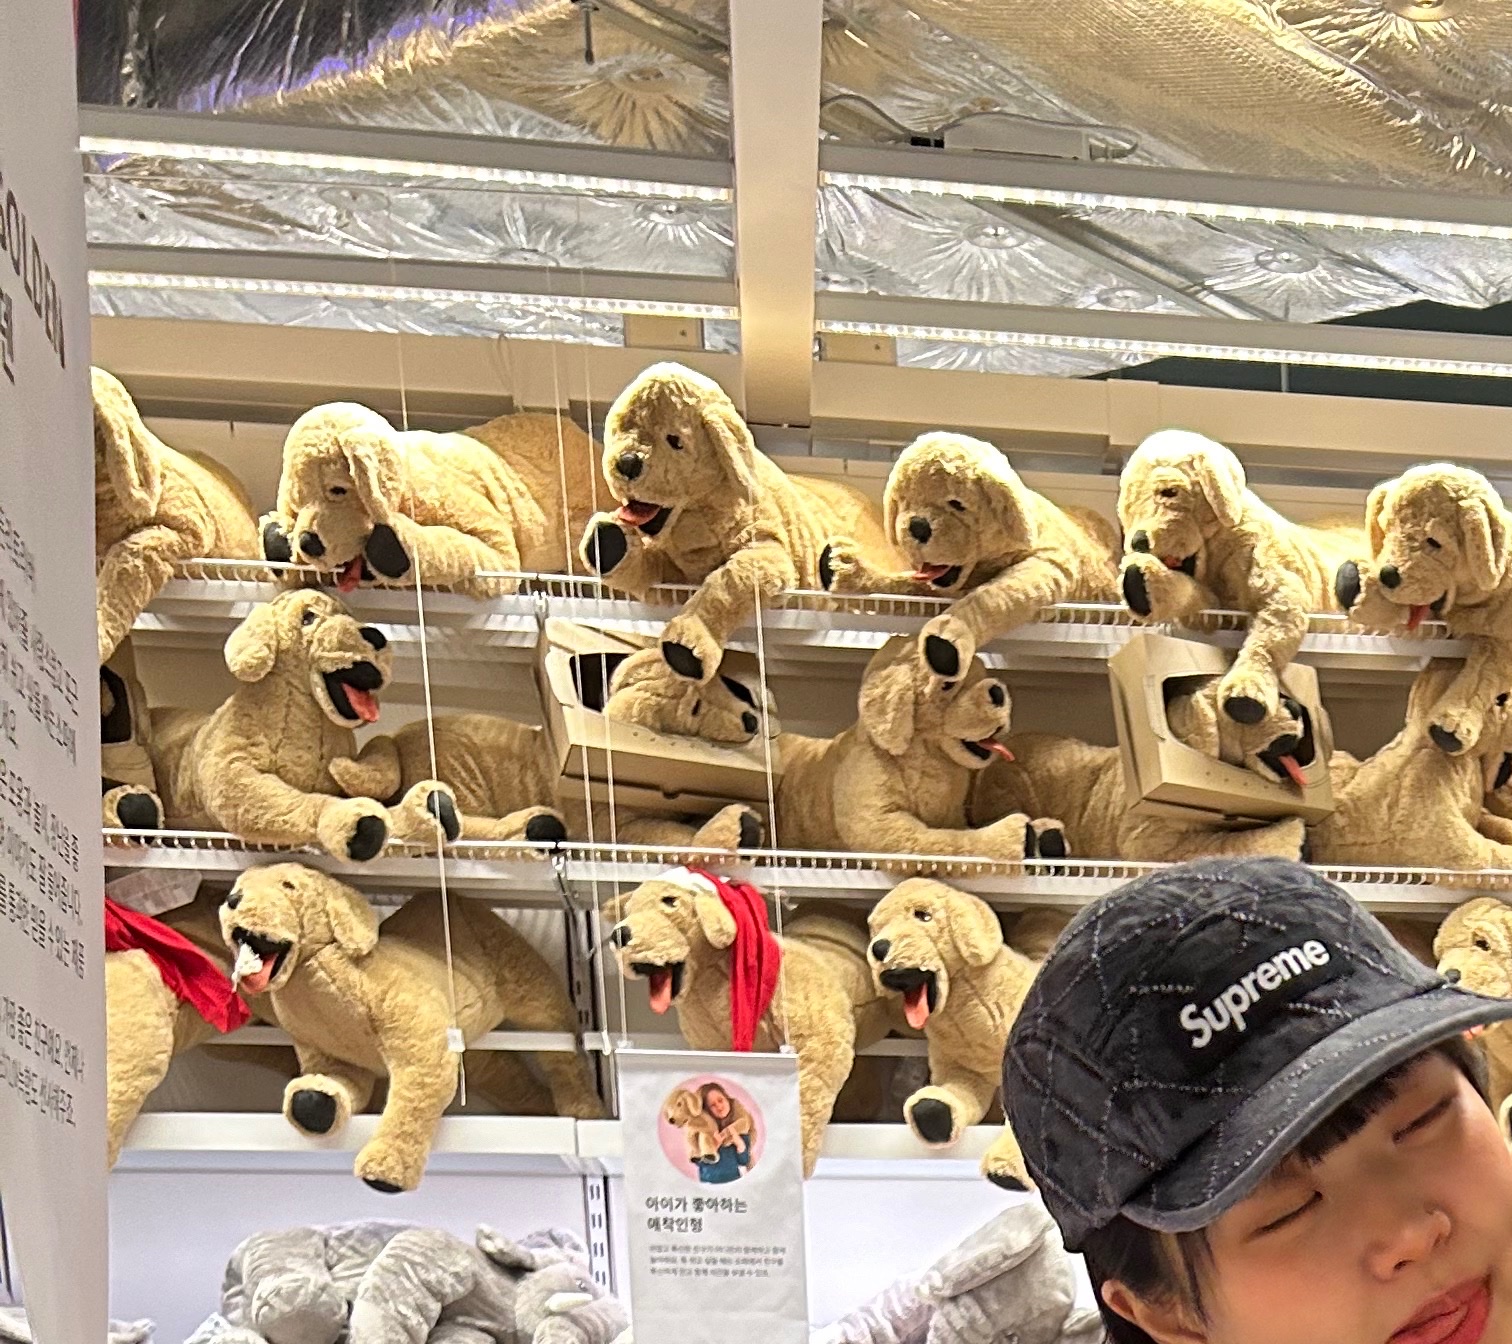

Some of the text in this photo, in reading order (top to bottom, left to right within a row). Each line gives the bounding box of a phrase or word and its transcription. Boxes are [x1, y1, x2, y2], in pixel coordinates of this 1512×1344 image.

[1179, 937, 1332, 1050] Supreme
[645, 1196, 748, 1214] 아이가 좋아하는
[647, 1216, 703, 1233] 애착인형
